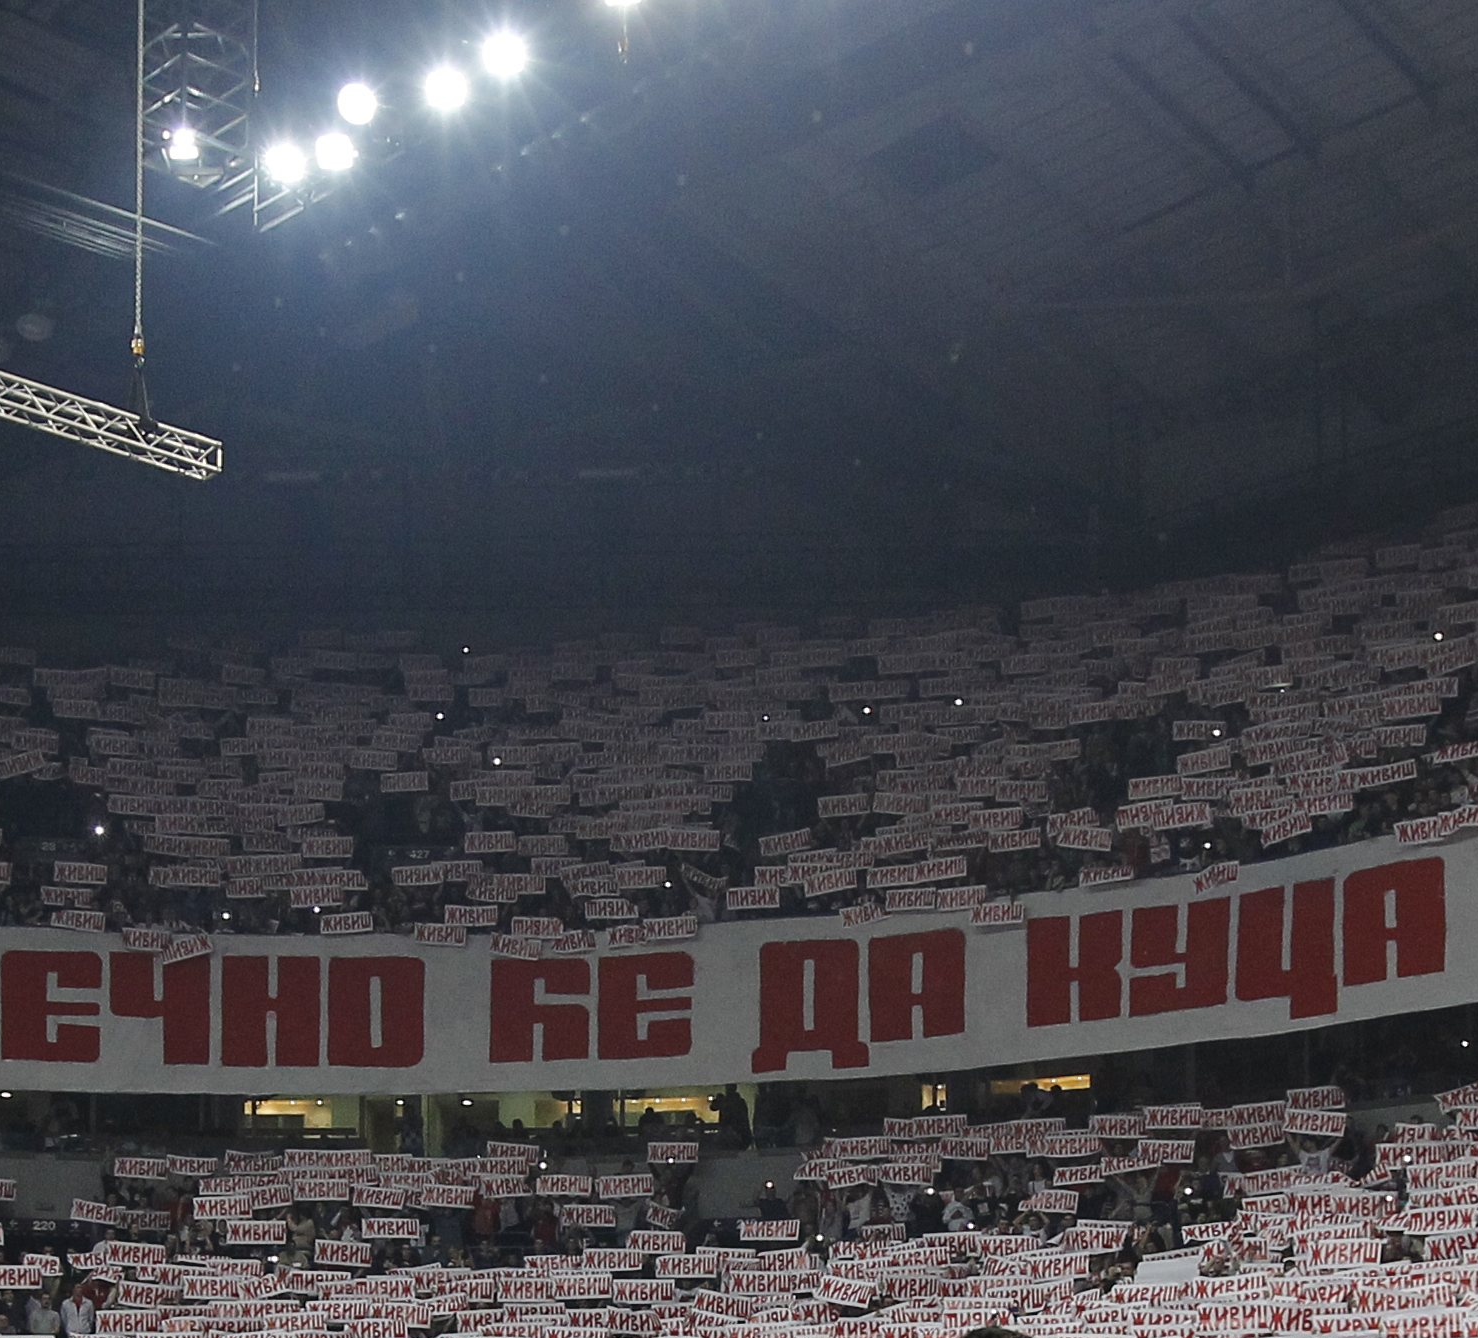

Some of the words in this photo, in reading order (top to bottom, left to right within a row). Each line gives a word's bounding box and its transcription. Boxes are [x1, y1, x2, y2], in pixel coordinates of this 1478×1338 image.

[751, 928, 967, 1073] ДА
[1026, 856, 1447, 1028] КУЦА
[119, 1160, 167, 1178] ЖИВИШ
[295, 1181, 349, 1199] ЖИВИШ
[194, 1198, 251, 1219] ЖИВИШ
[563, 1207, 615, 1226] ЖИВИШ
[33, 1220, 56, 1231] 220
[228, 1222, 286, 1243] ЖИВИШ
[363, 1219, 418, 1238] ЖИВИШ
[741, 1221, 798, 1238] ЖИВИШ
[110, 1244, 164, 1264] ЖИВИШ
